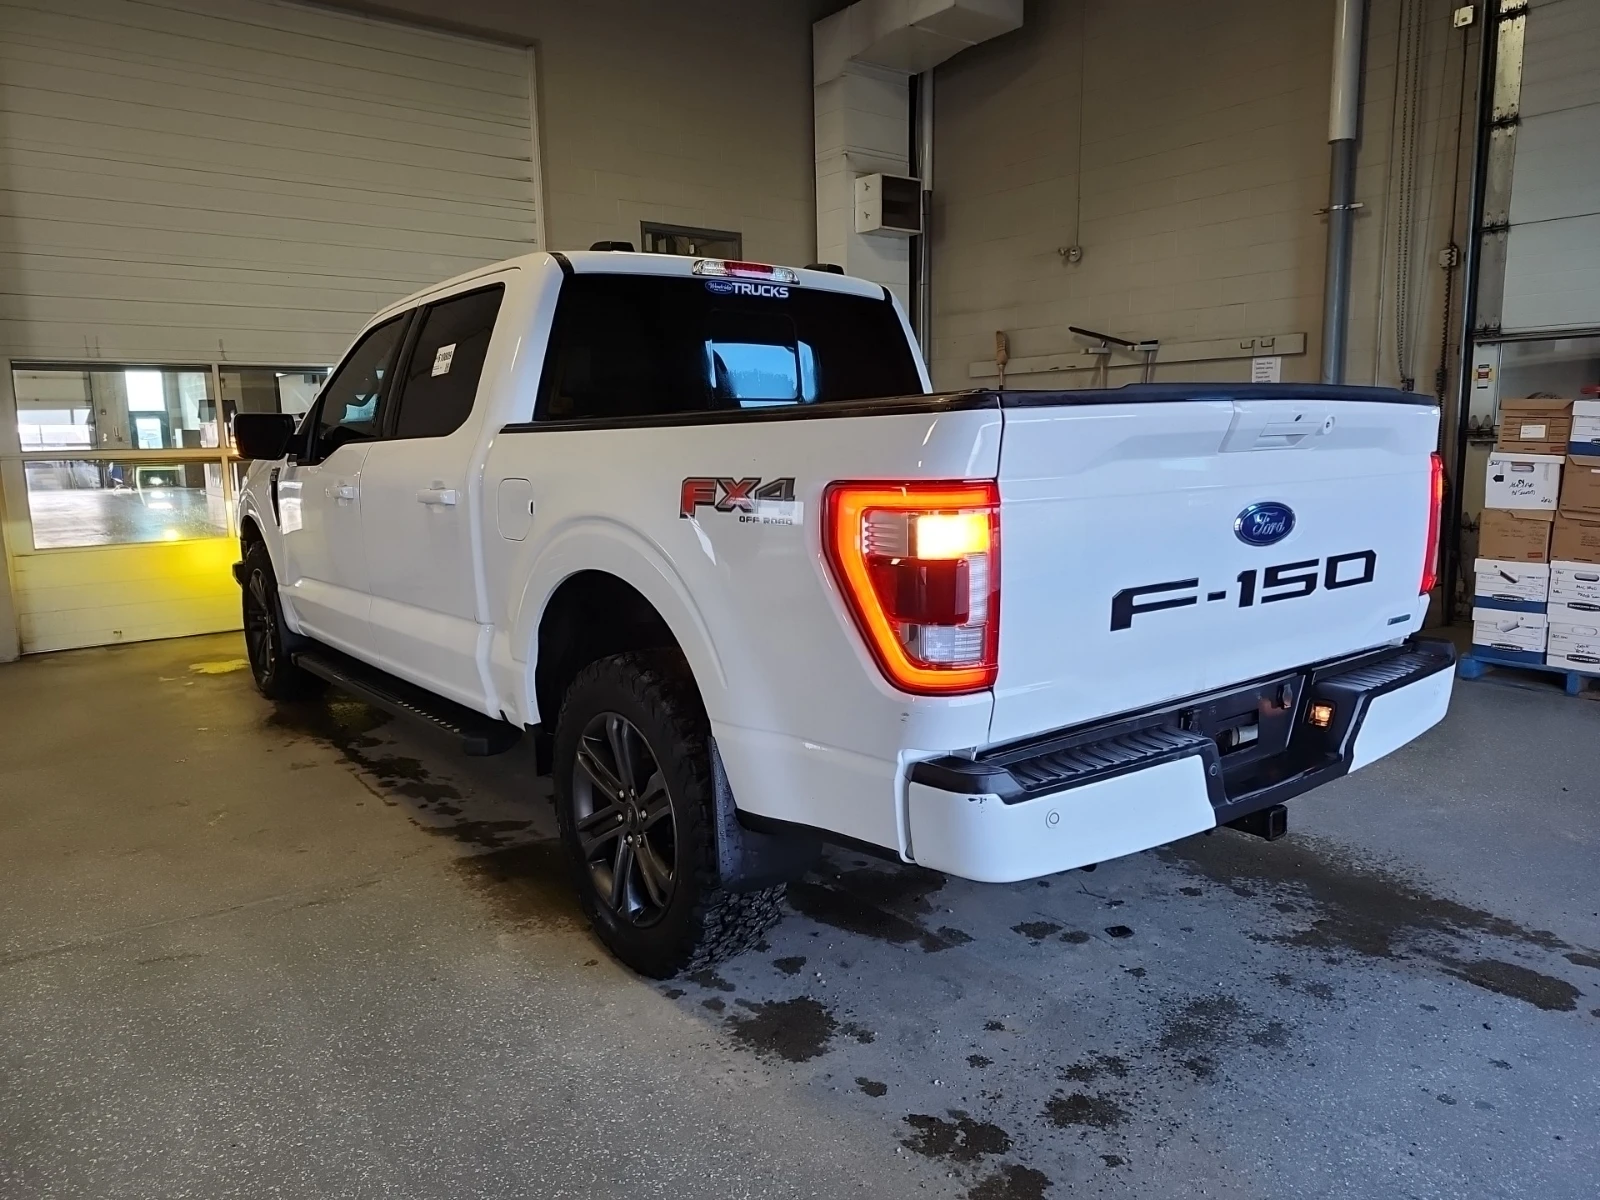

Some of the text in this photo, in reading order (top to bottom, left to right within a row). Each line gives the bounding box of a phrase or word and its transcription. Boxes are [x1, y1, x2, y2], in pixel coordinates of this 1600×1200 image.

[732, 282, 789, 298] TRUCKS
[680, 477, 796, 519] FX4
[738, 515, 760, 524] OFF
[1110, 549, 1377, 632] F-150
